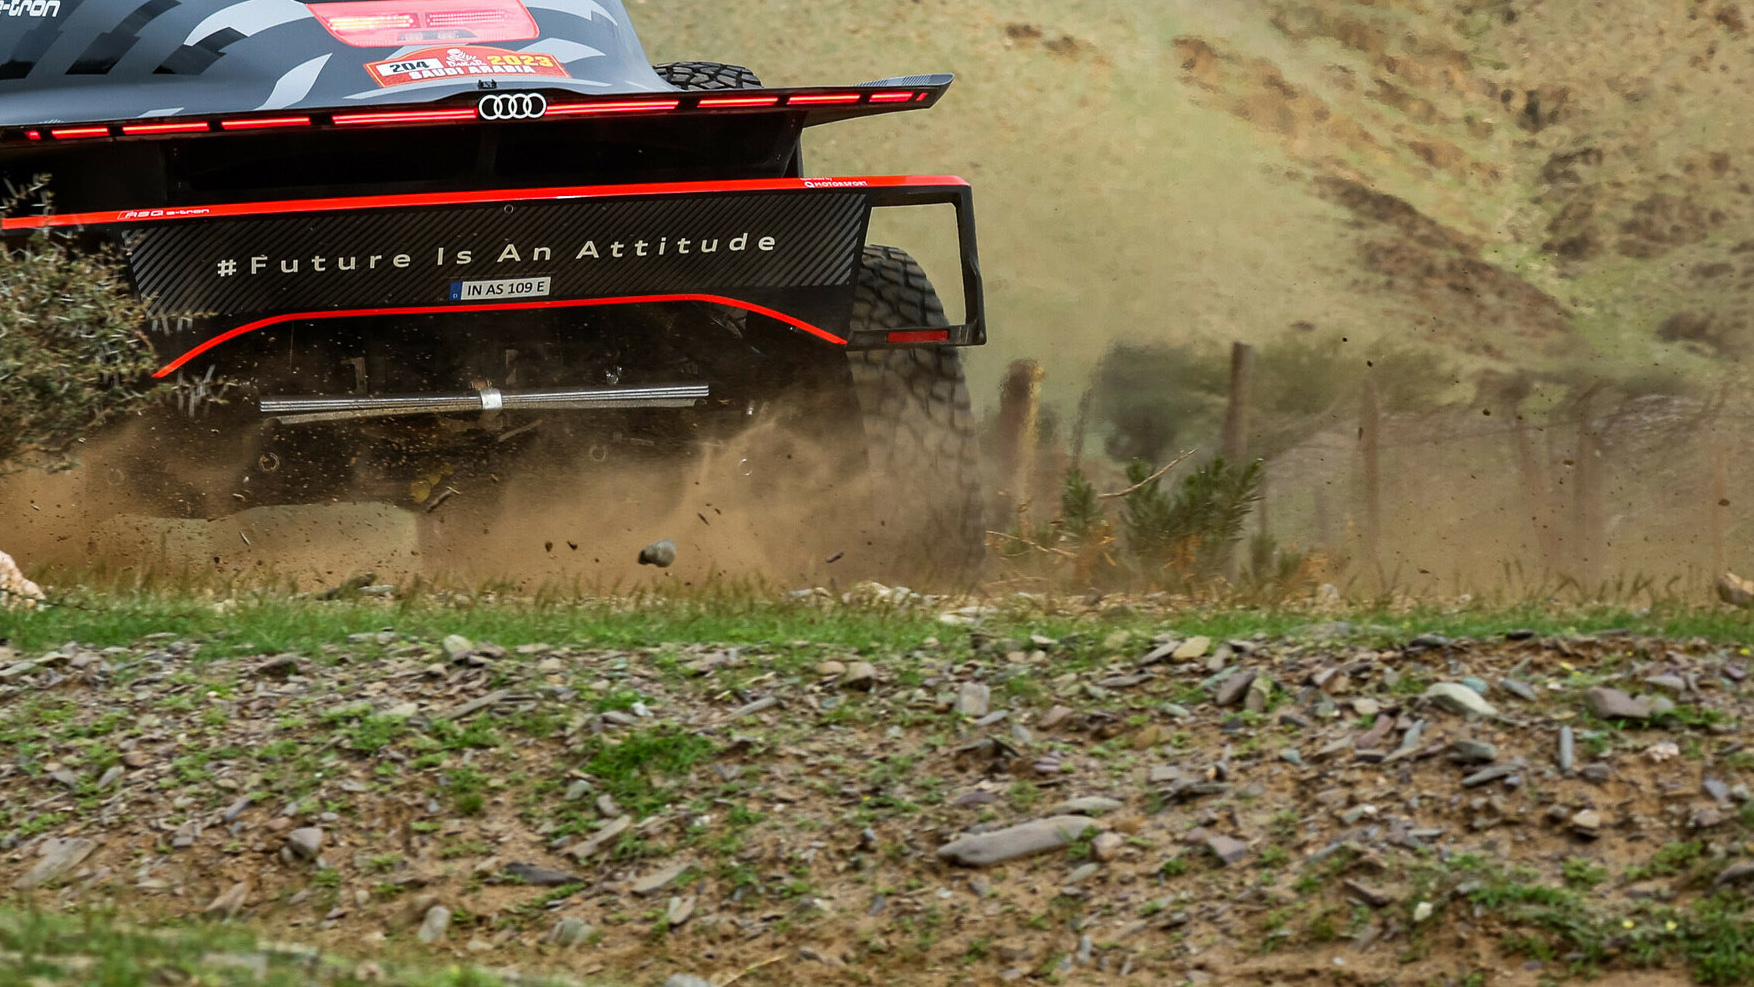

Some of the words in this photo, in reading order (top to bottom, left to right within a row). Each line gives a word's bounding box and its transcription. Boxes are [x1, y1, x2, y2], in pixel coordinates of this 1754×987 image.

[389, 60, 430, 73] 204
[487, 55, 554, 67] 2023
[409, 67, 465, 80] SAUDI
[466, 64, 536, 75] ARABIA
[166, 208, 210, 216] e-tron
[217, 253, 411, 277] #Future
[437, 247, 472, 265] Is
[497, 243, 551, 262] An
[575, 233, 776, 260] Attitude
[467, 285, 483, 296] IN
[486, 283, 504, 295] AS
[508, 281, 533, 294] 109
[536, 280, 545, 292] E
